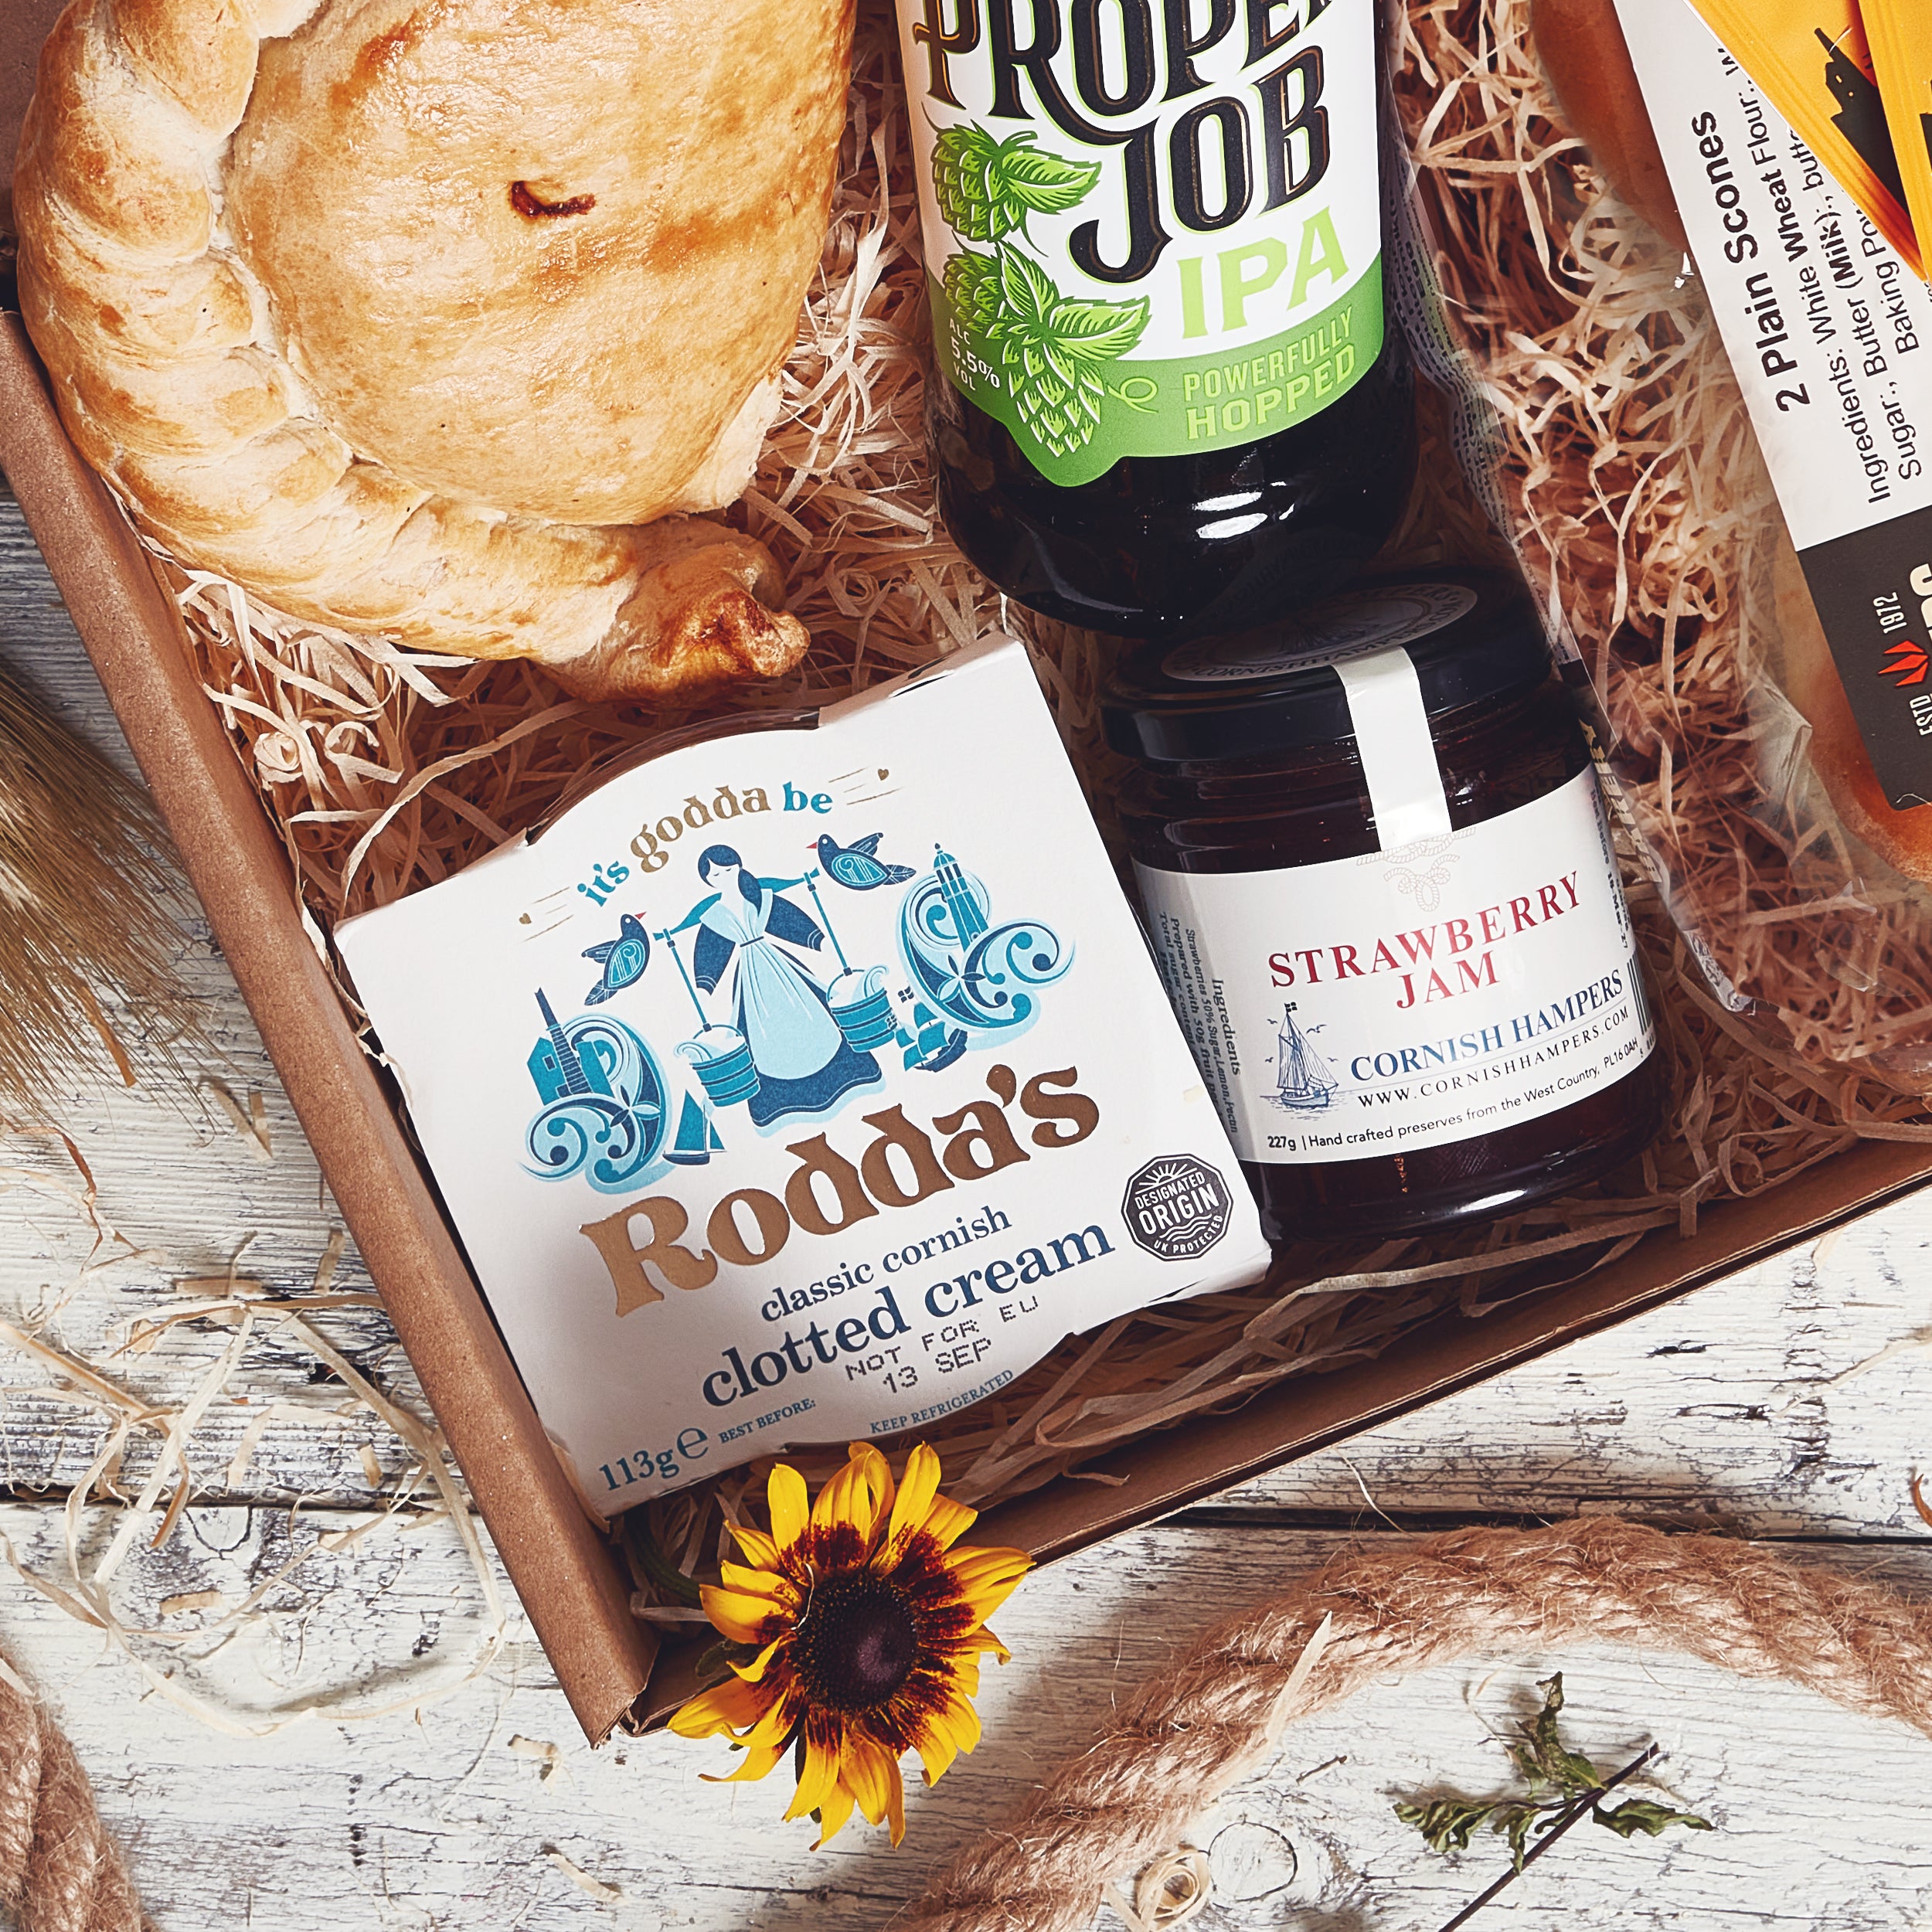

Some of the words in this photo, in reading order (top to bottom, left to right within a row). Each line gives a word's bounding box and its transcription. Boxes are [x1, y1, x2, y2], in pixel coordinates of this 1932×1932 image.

[1069, 44, 1332, 284] JOB
[1691, 111, 1759, 264] Scones
[1760, 168, 1808, 261] Wheat
[1176, 204, 1350, 340] IPA
[1799, 265, 1836, 345] White
[1876, 260, 1920, 354] Baking
[950, 318, 971, 345] ALC
[951, 335, 1001, 389] 5.5%
[1183, 305, 1352, 402] POWERFULLY
[1745, 272, 1798, 377] Plain
[1847, 298, 1888, 377] Butter
[954, 361, 976, 391] VOL
[1186, 344, 1355, 440] HOPPED
[1775, 383, 1810, 412] 2
[1826, 348, 1891, 504] Ingredients:
[1872, 592, 1907, 634] 1972
[577, 860, 630, 907] it's
[631, 784, 772, 873] godda
[782, 781, 833, 814] be
[1579, 718, 1662, 883] BAKERY
[1159, 911, 1175, 949] Total
[1185, 928, 1207, 997] Strawberries
[1201, 998, 1213, 1024] 50%
[1268, 870, 1581, 988] STRAWBERRY
[1169, 917, 1192, 980] Prepared
[1186, 985, 1199, 1014] with
[1200, 1046, 1215, 1080] fruit
[1211, 978, 1241, 1077] Ingredients
[1351, 1024, 1505, 1082] CORNISH
[1510, 968, 1624, 1043] HAMPERS
[1396, 950, 1499, 1009] JAM
[1267, 1134, 1296, 1151] 227g
[1308, 1133, 1343, 1148] Hand
[1346, 1126, 1394, 1144] crafted
[1398, 1114, 1463, 1139] preserves
[1466, 1106, 1498, 1121] from
[1501, 1096, 1522, 1111] the
[1524, 1084, 1556, 1103] West
[1557, 1066, 1600, 1090] Country,
[1604, 1047, 1624, 1069] PL16
[1358, 1005, 1629, 1108] WWW.CORNISHHAMPERS.COM
[580, 1063, 1100, 1318] Rodda's
[1134, 1171, 1206, 1210] DESIGNATED
[1138, 1183, 1219, 1235] ORIGIN
[1154, 1240, 1168, 1253] UK
[1172, 1215, 1223, 1253] PROTECTED
[760, 1262, 875, 1322] classic
[882, 1206, 1012, 1274] cornish
[702, 1285, 912, 1407] clotted
[923, 1223, 1116, 1318] cream
[845, 1345, 903, 1381] NOT
[921, 1319, 981, 1352] FOR
[998, 1295, 1039, 1323] EU
[869, 1415, 908, 1435] KEEP
[910, 1369, 1014, 1425] REFRIGERATED
[883, 1365, 918, 1393] 13
[934, 1337, 992, 1373] SEP
[718, 1422, 754, 1444] BEST
[756, 1398, 817, 1432] BEFORE:
